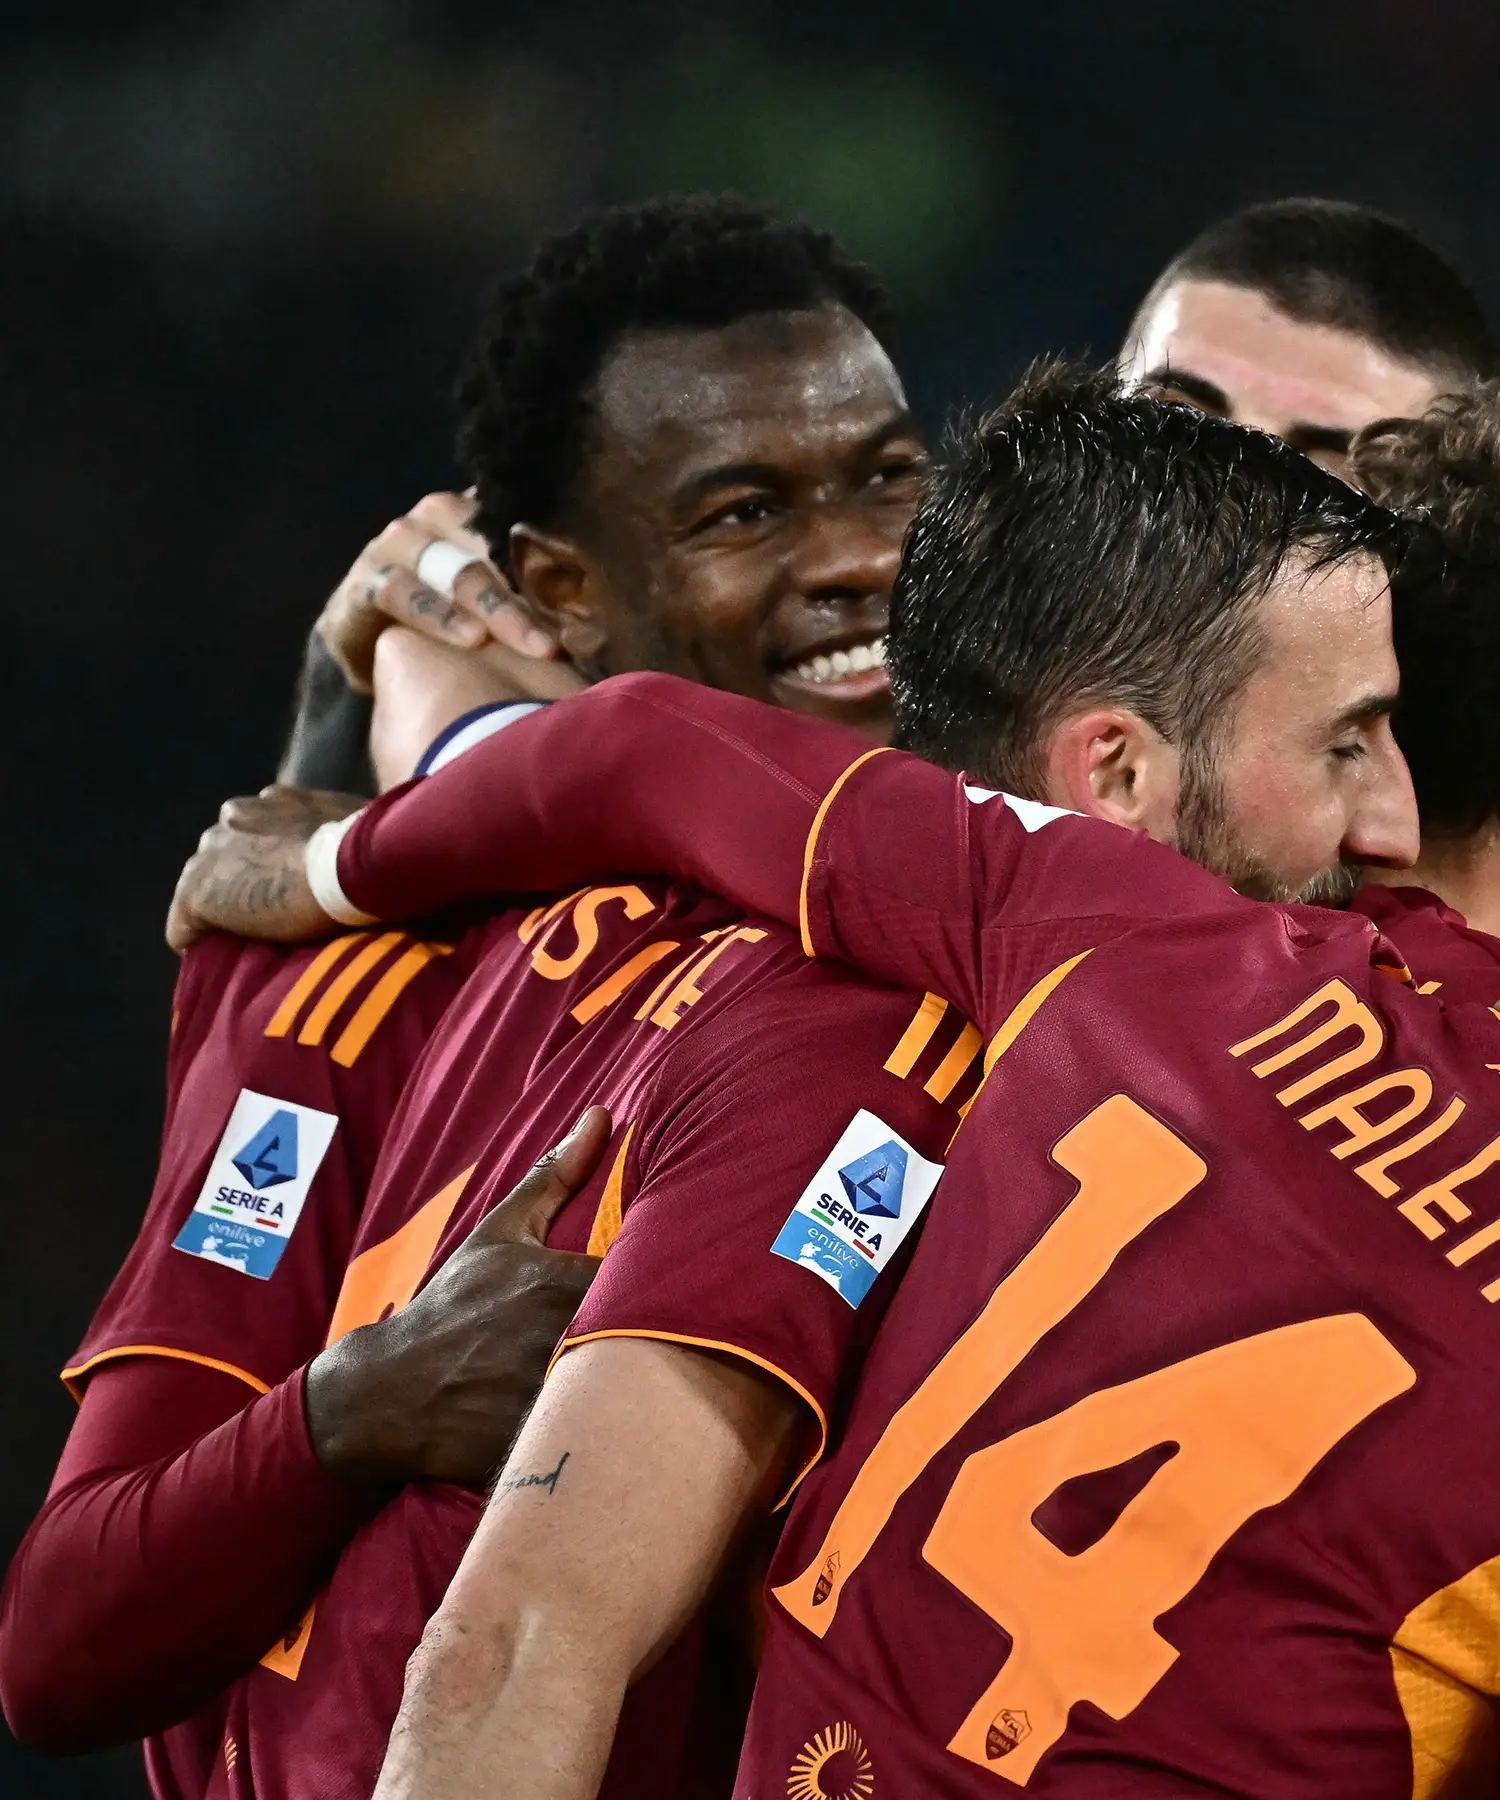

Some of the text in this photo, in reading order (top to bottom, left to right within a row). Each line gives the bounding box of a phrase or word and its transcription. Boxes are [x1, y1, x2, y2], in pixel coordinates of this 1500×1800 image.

[215, 1186, 284, 1218] SERIE A
[816, 1193, 883, 1251] SERIE A
[208, 1220, 266, 1248] enilive
[807, 1226, 859, 1270] enilive
[771, 1093, 1417, 1787] 14
